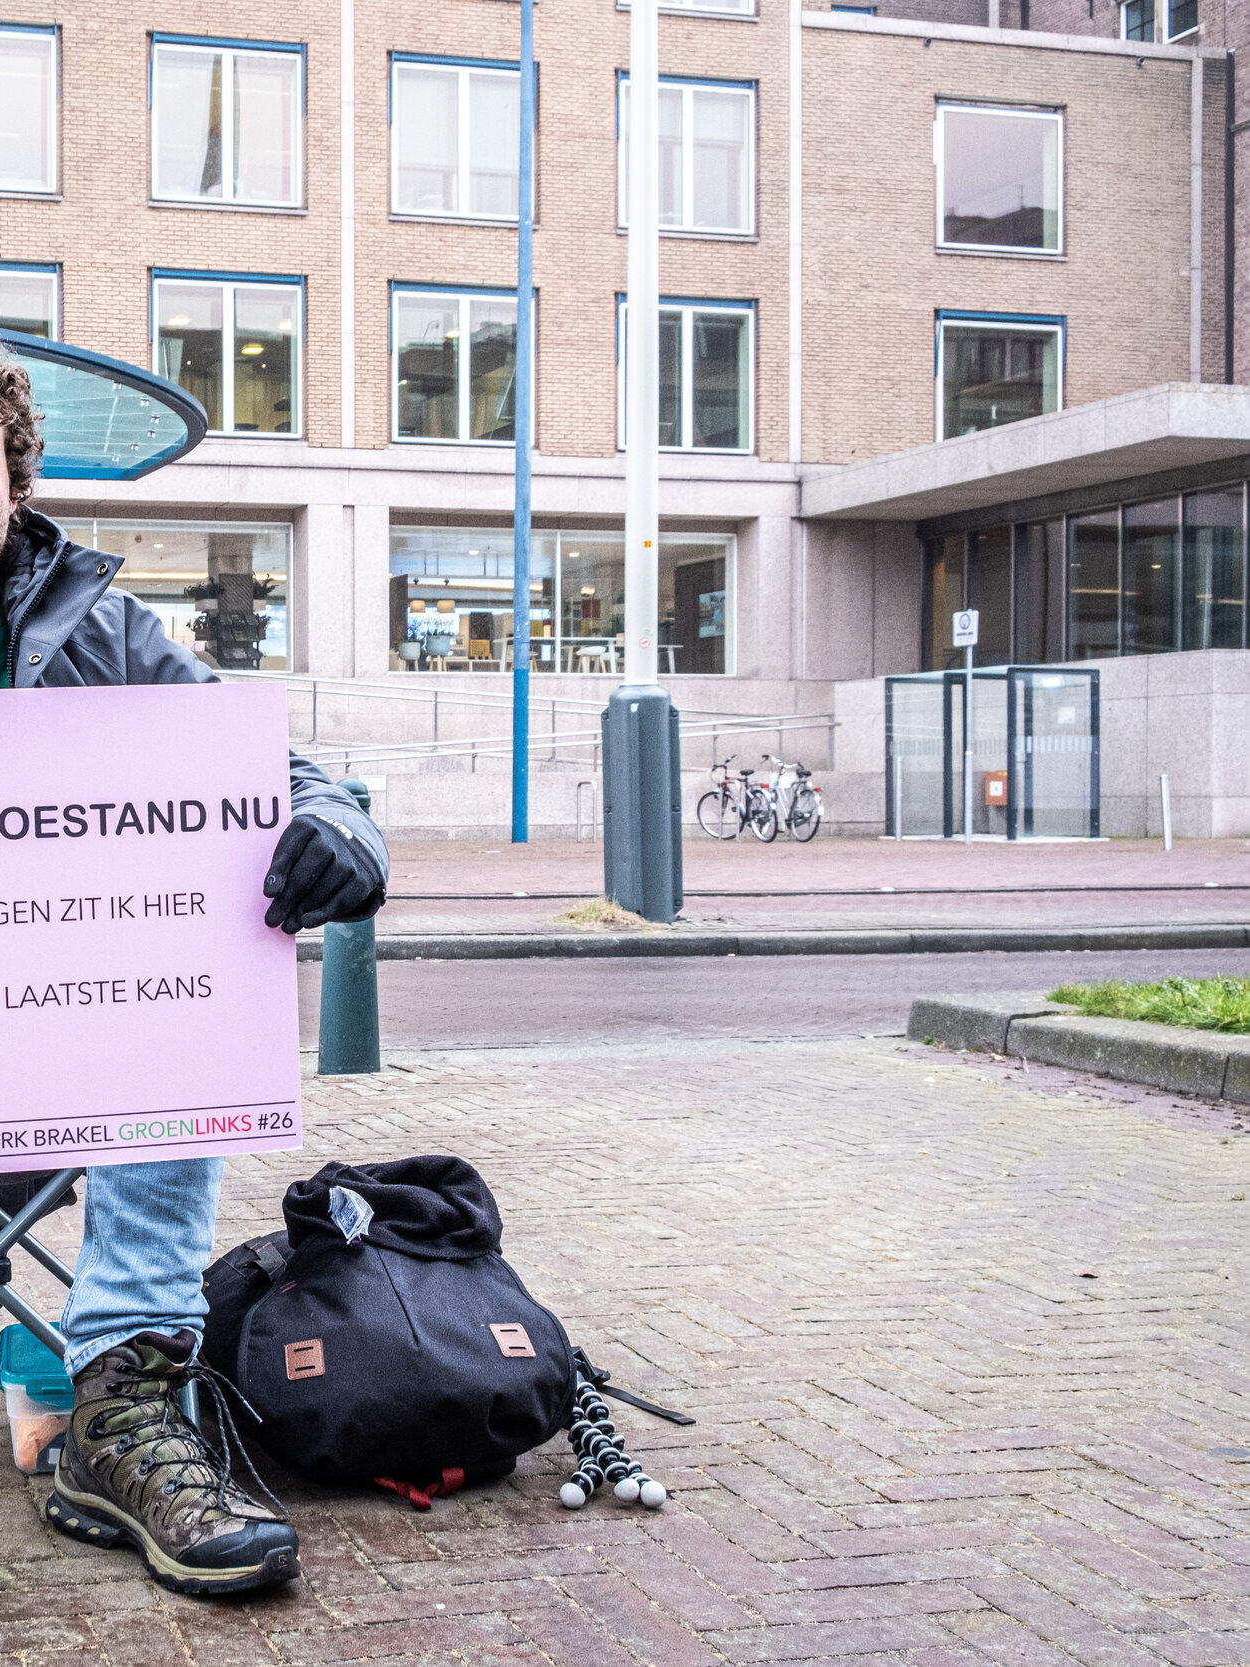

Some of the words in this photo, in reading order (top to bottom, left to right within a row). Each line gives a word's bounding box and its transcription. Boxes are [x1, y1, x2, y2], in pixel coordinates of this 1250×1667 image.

[221, 795, 280, 832] NU
[59, 896, 102, 922] ZIT
[110, 895, 136, 920] IK
[144, 892, 206, 918] HIER
[5, 979, 128, 1010] LAATSTE
[136, 974, 212, 1002] KANS
[33, 1125, 116, 1148] BRAKEL
[118, 1114, 252, 1141] GROENLINKS
[257, 1111, 294, 1131] #26
